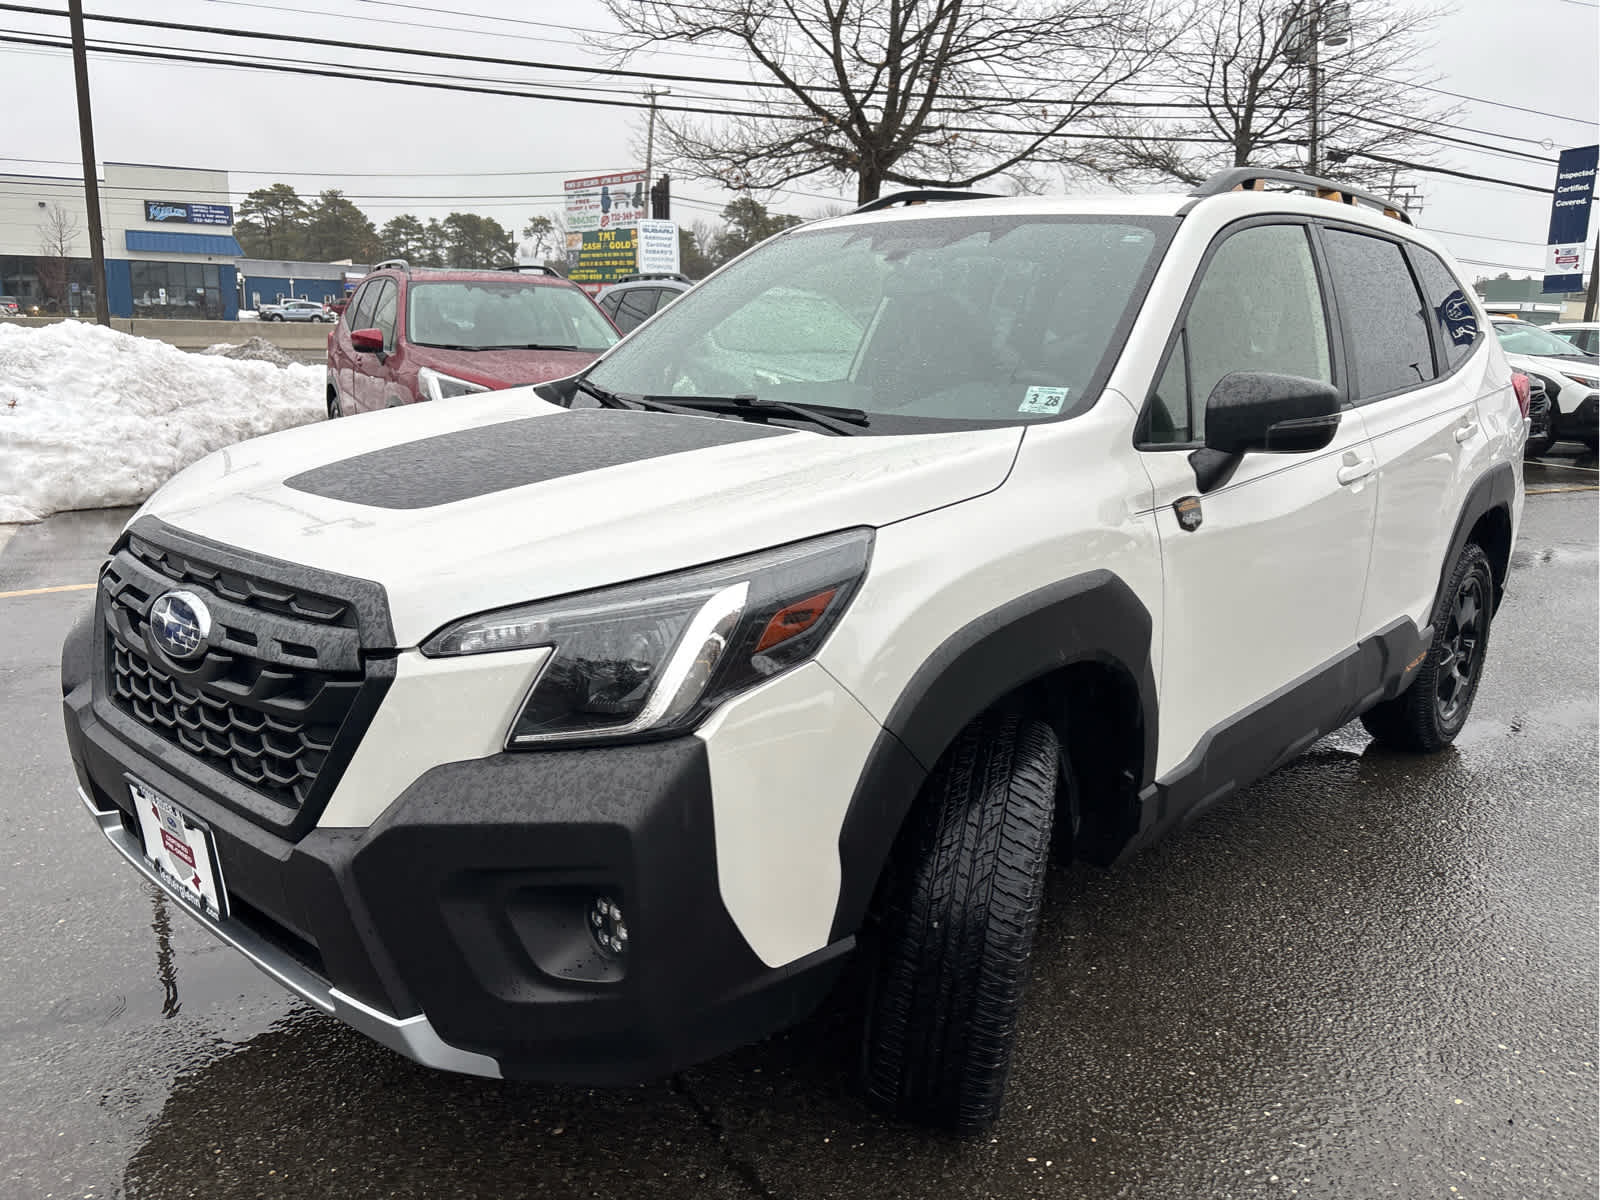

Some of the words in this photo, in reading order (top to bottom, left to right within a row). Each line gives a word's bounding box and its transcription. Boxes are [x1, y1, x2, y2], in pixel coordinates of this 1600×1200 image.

[1560, 169, 1595, 180] Inspected.
[1557, 183, 1590, 193] Certified.
[1555, 198, 1587, 207] Covered.
[597, 231, 617, 241] TMT
[583, 242, 601, 251] CASH
[609, 240, 631, 249] GOLD
[1029, 393, 1039, 404] 3
[1044, 395, 1061, 407] 28
